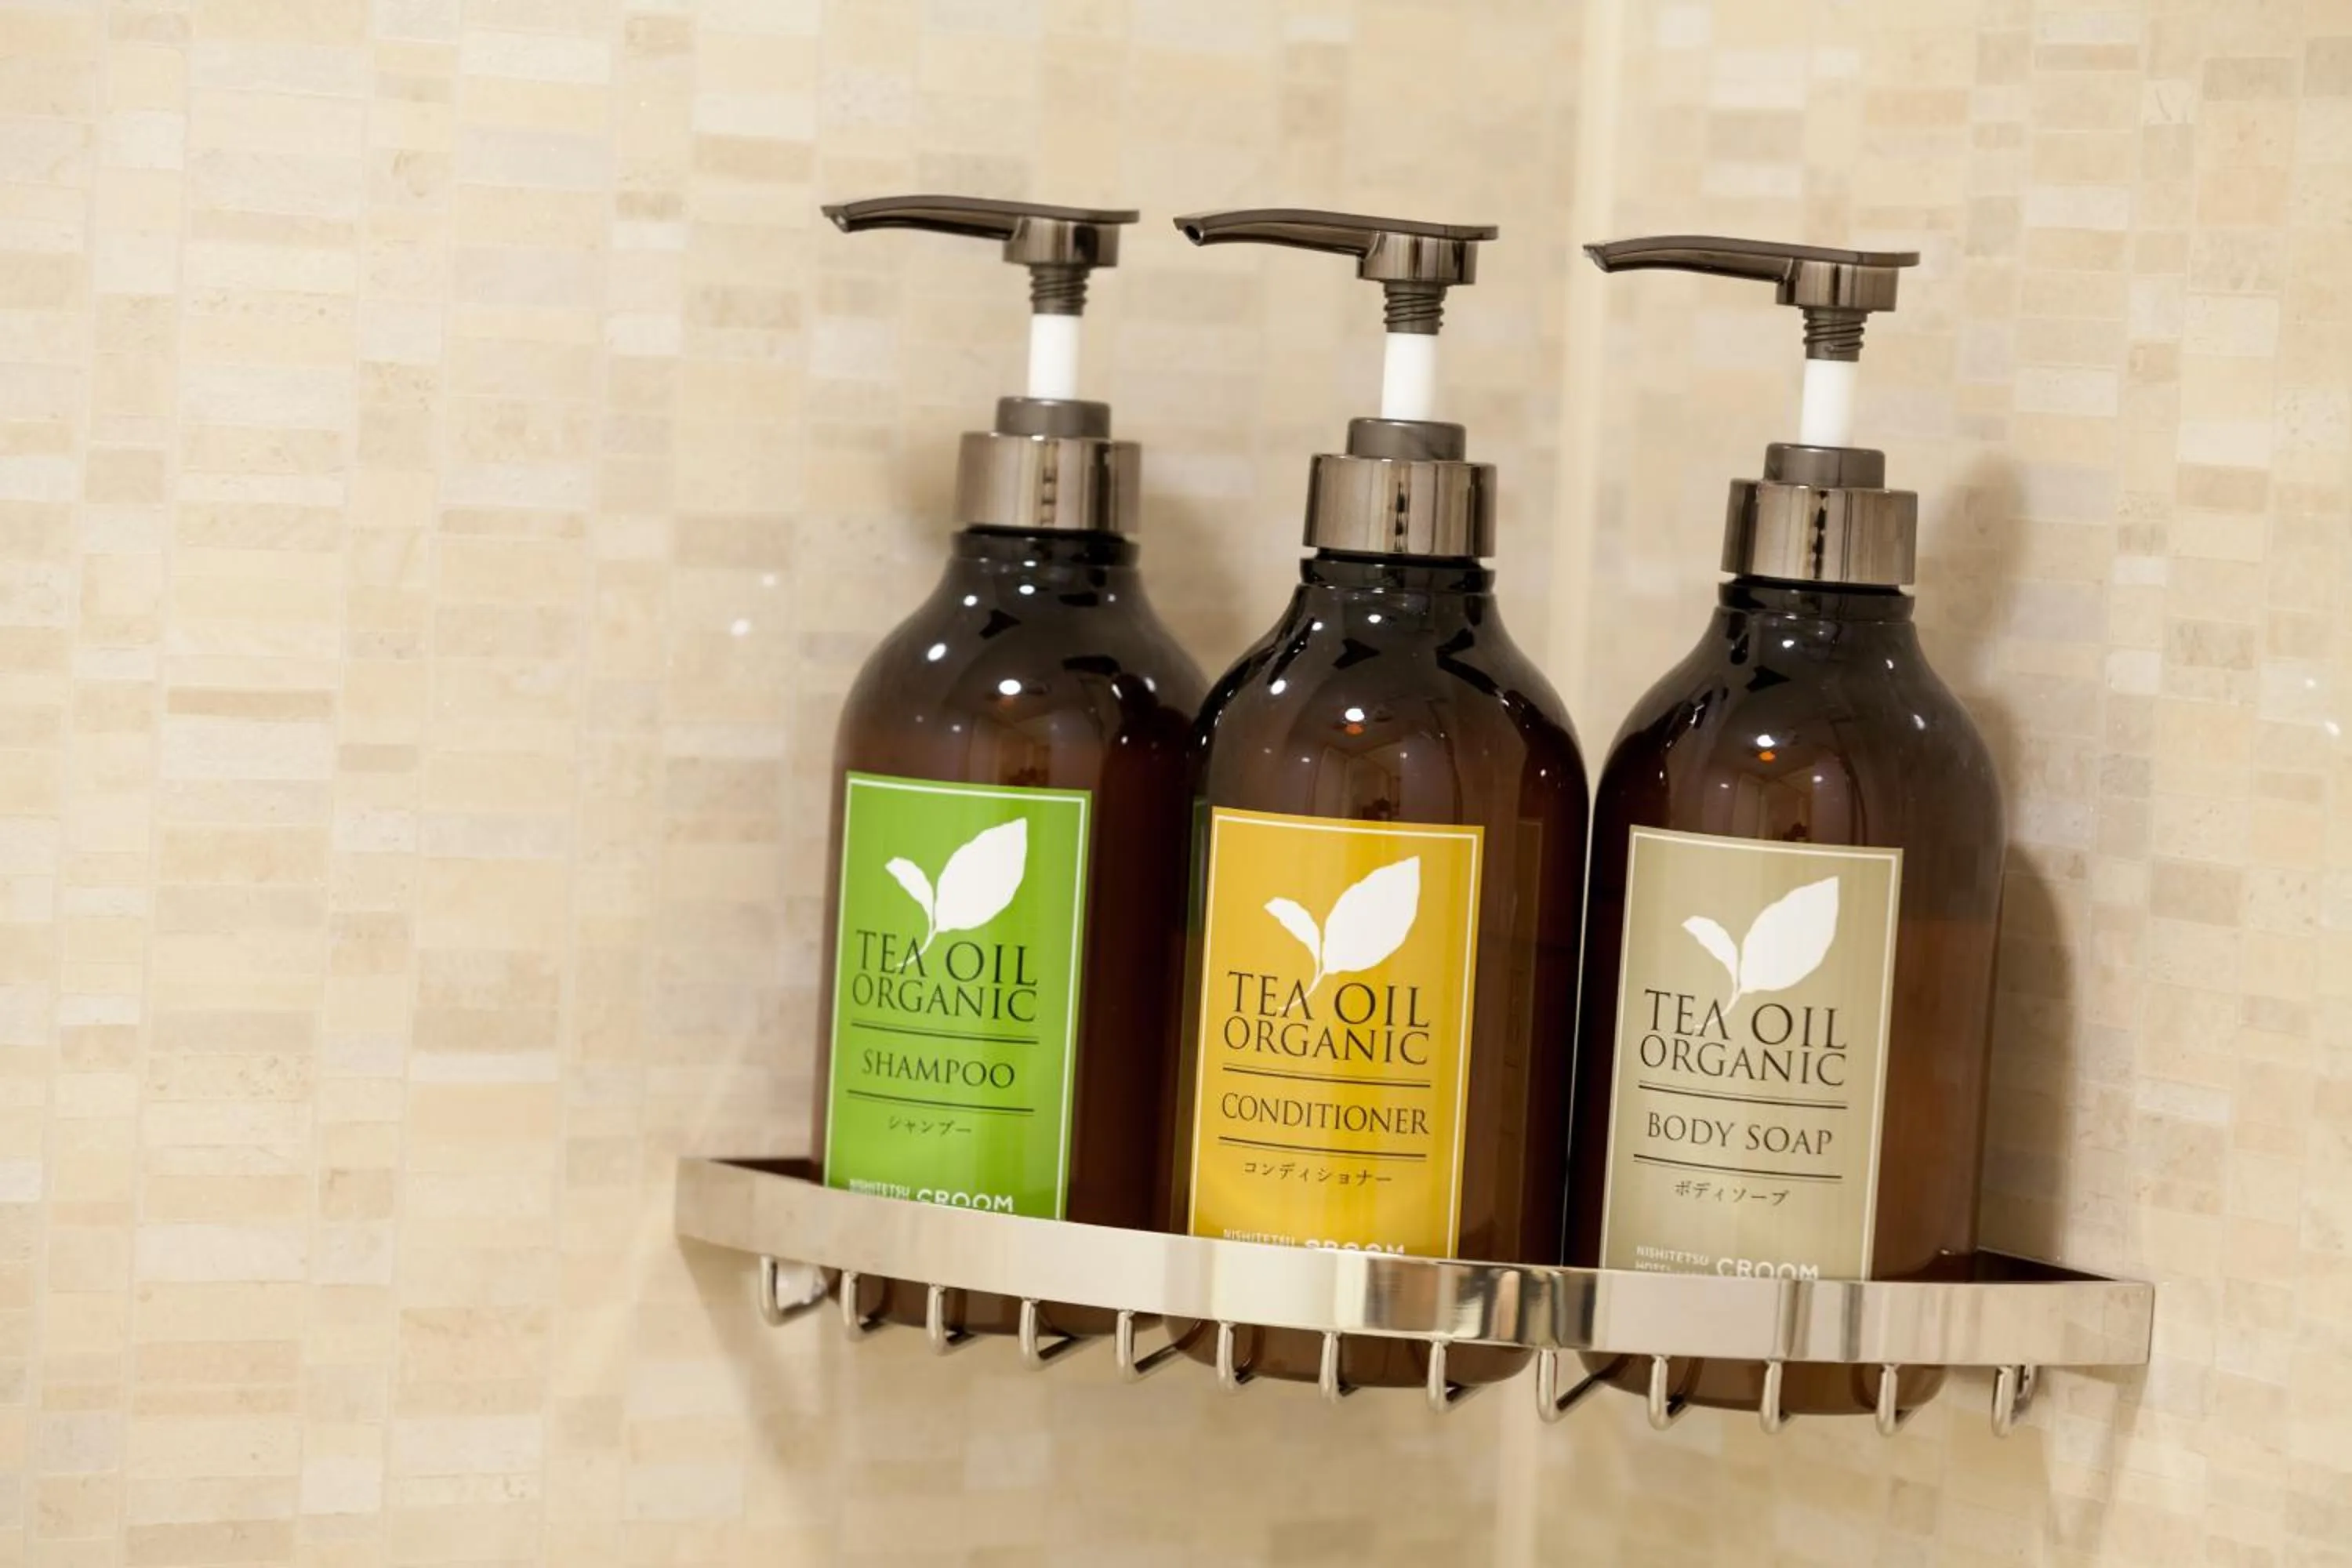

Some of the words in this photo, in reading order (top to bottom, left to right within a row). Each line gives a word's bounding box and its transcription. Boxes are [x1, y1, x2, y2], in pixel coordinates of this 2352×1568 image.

[856, 929, 927, 978] TEA
[946, 941, 1038, 985] OIL
[852, 973, 1038, 1022] ORGANIC
[1227, 971, 1314, 1020] TEA
[1334, 982, 1431, 1029] OIL
[1644, 989, 1731, 1040] TEA
[1751, 1003, 1847, 1049] OIL
[1224, 1015, 1430, 1065] ORGANIC
[1640, 1034, 1847, 1086] ORGANIC
[862, 1048, 1015, 1089] SHAMPOO
[1221, 1092, 1430, 1135] CONDITIONER
[1647, 1112, 1735, 1147] BODY
[1745, 1124, 1833, 1156] SOAP
[1243, 1162, 1392, 1186] コンディショナー
[1675, 1181, 1790, 1206] ボディソープ
[1636, 1246, 1709, 1267] NISHITETSU
[1717, 1258, 1819, 1280] CROOM
